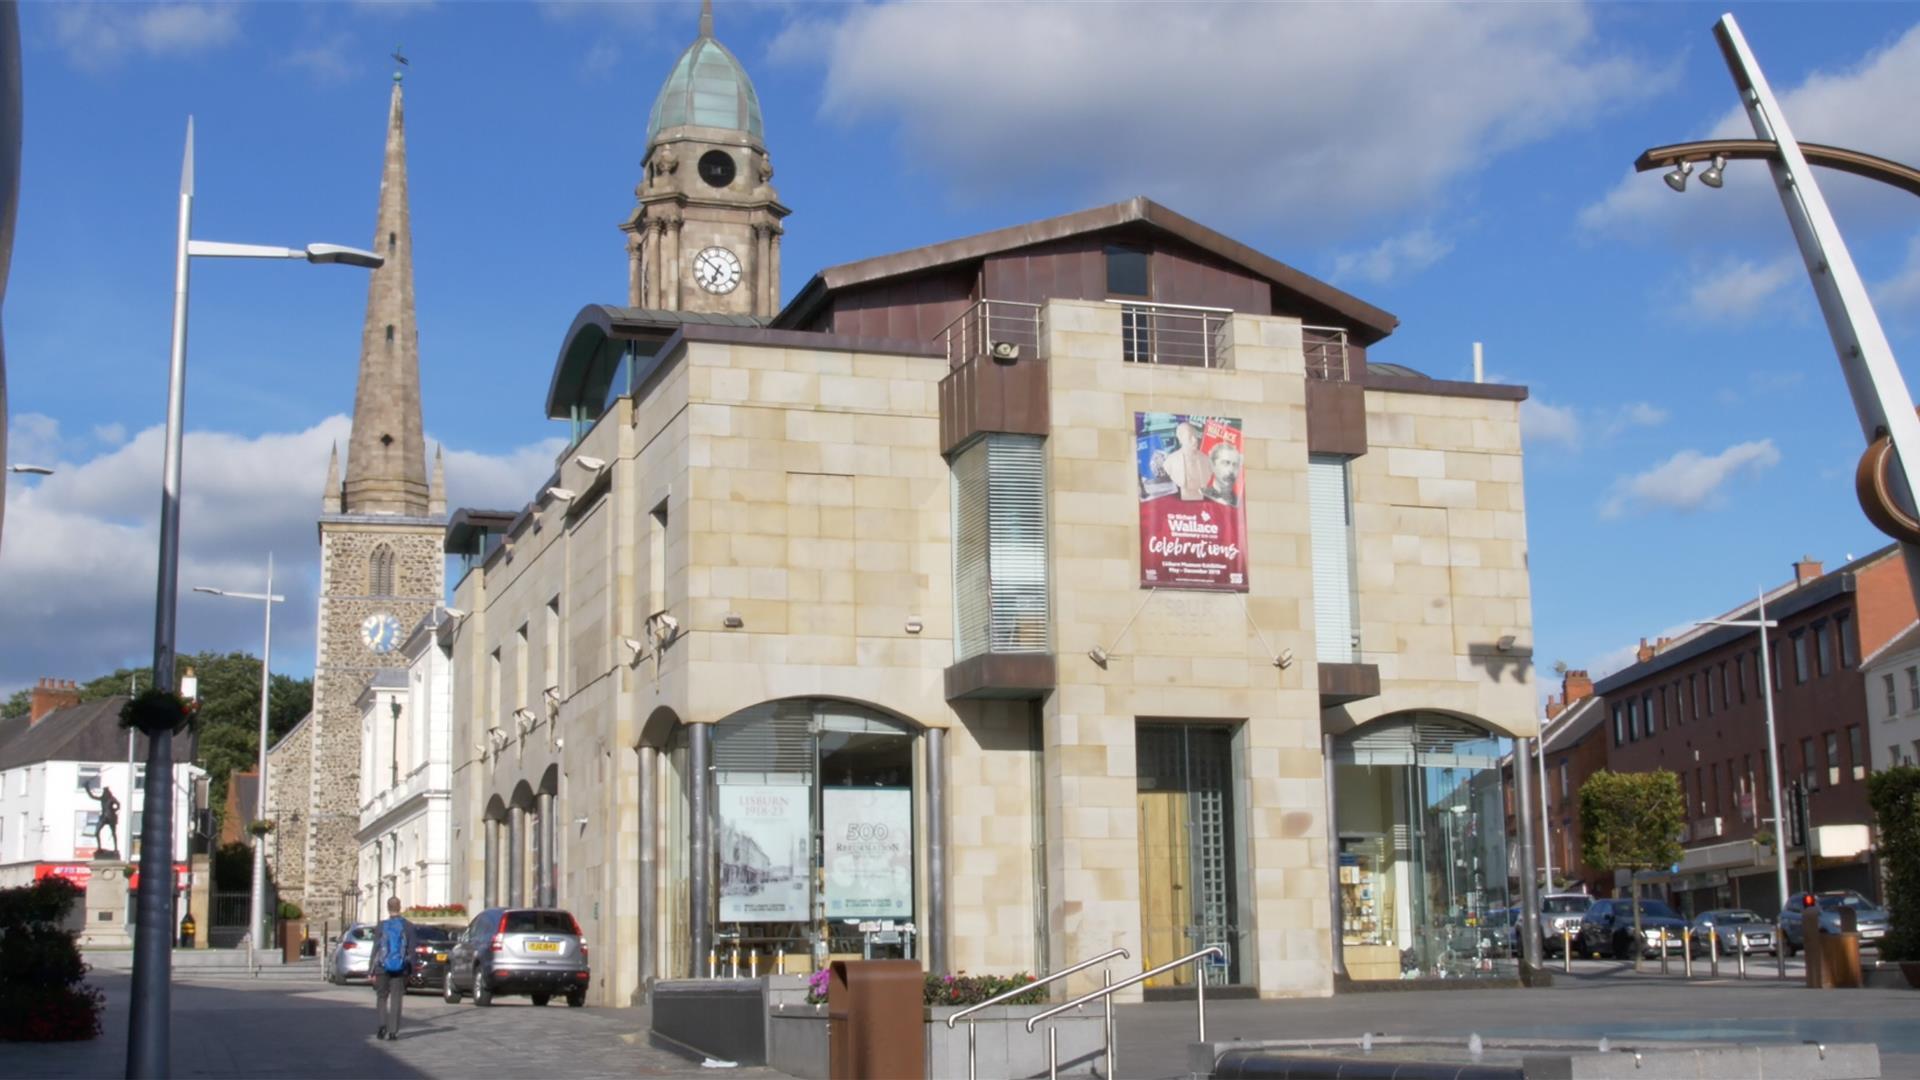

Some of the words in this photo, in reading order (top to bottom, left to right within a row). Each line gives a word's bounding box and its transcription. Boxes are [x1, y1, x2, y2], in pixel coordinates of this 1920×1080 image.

[1167, 519, 1218, 534] Wallace
[1149, 536, 1240, 560] Celebrations
[739, 795, 789, 806] LISBURN
[846, 822, 889, 841] 500
